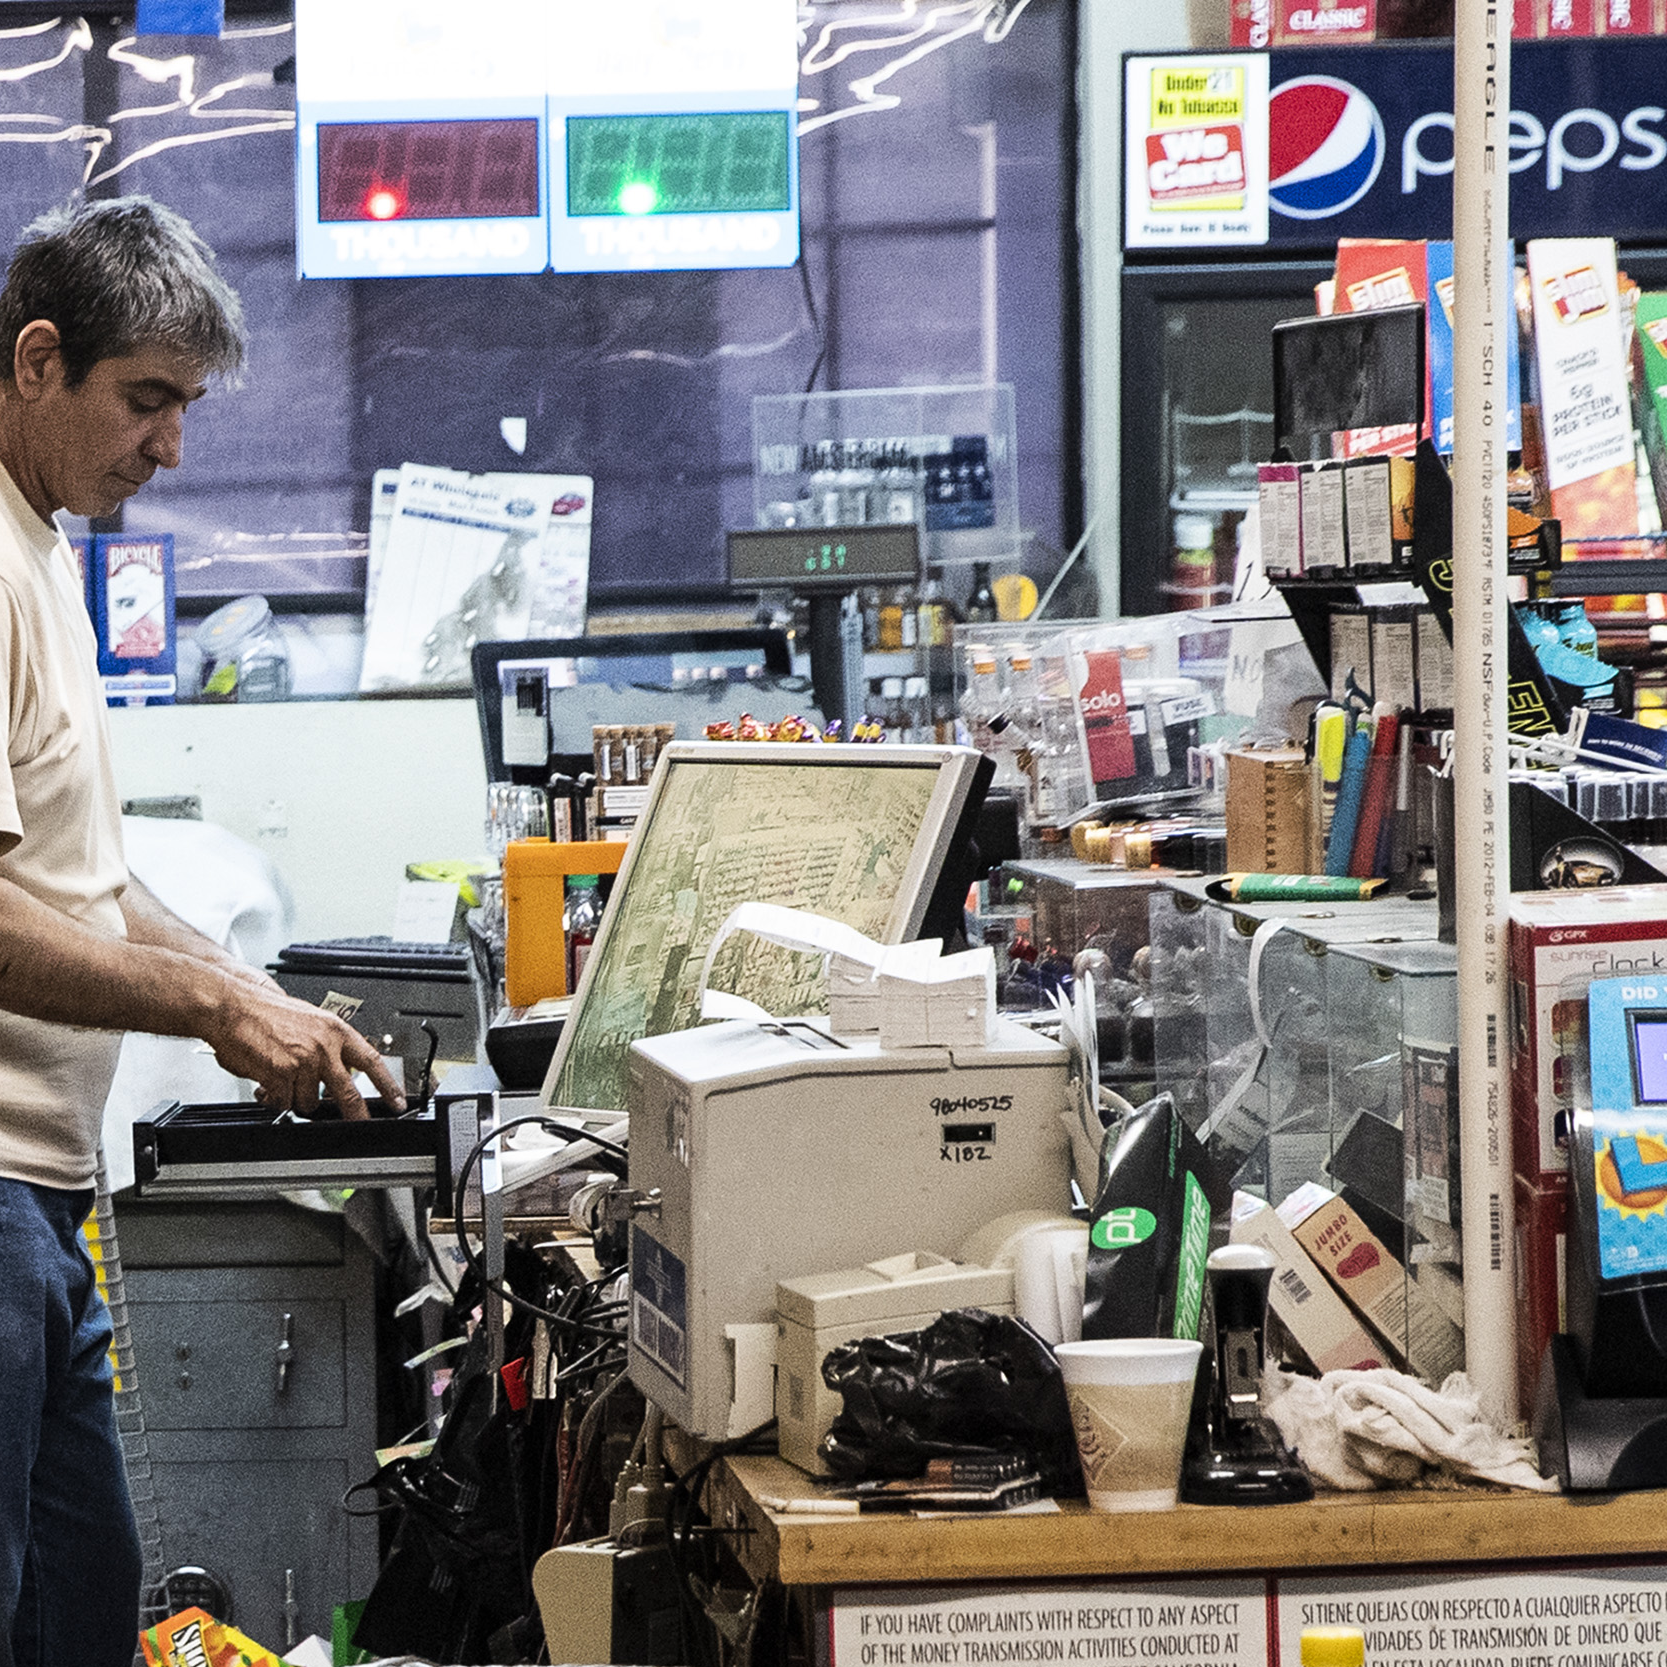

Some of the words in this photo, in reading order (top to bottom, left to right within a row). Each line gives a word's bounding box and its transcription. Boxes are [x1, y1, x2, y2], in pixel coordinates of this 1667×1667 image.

[1289, 6, 1367, 32] CLASSIC
[1160, 130, 1229, 163] We
[1148, 150, 1243, 191] Card
[331, 223, 530, 261] THOUSAND
[580, 218, 781, 256] THOUSAND
[109, 545, 163, 571] BICYCLE
[1080, 689, 1121, 711] solo
[1550, 948, 1608, 964] sunrise
[1621, 986, 1658, 1001] DID
[1312, 1213, 1351, 1252] JUMBO
[1329, 1230, 1354, 1258] SIZE
[860, 1614, 870, 1636] IF
[876, 1613, 903, 1636] YOU
[908, 1613, 941, 1635] HAVE
[948, 1611, 1033, 1634] COMPLAINTS
[1037, 1611, 1072, 1631] WITH
[1078, 1607, 1133, 1630] RESPECT
[1138, 1606, 1154, 1628] TO
[1158, 1606, 1184, 1627] ANY
[1191, 1603, 1238, 1627] ASPECT
[1301, 1603, 1315, 1625] SI
[1317, 1601, 1352, 1625] TIENE
[1356, 1601, 1408, 1625] QUEJAS
[1411, 1600, 1440, 1622] CON
[1443, 1596, 1510, 1622] RESPECTO
[1513, 1599, 1525, 1619] A
[1525, 1595, 1601, 1620] CUALQUIER
[1603, 1592, 1663, 1615] ASPECTO
[860, 1642, 877, 1667] OF
[881, 1642, 905, 1666] THE
[911, 1641, 960, 1665] MONEY
[963, 1637, 1064, 1664] TRANSMISSION
[1068, 1635, 1137, 1660] ACTIVITIES
[1140, 1632, 1221, 1658] CONDUCTED
[1224, 1632, 1239, 1655] AT
